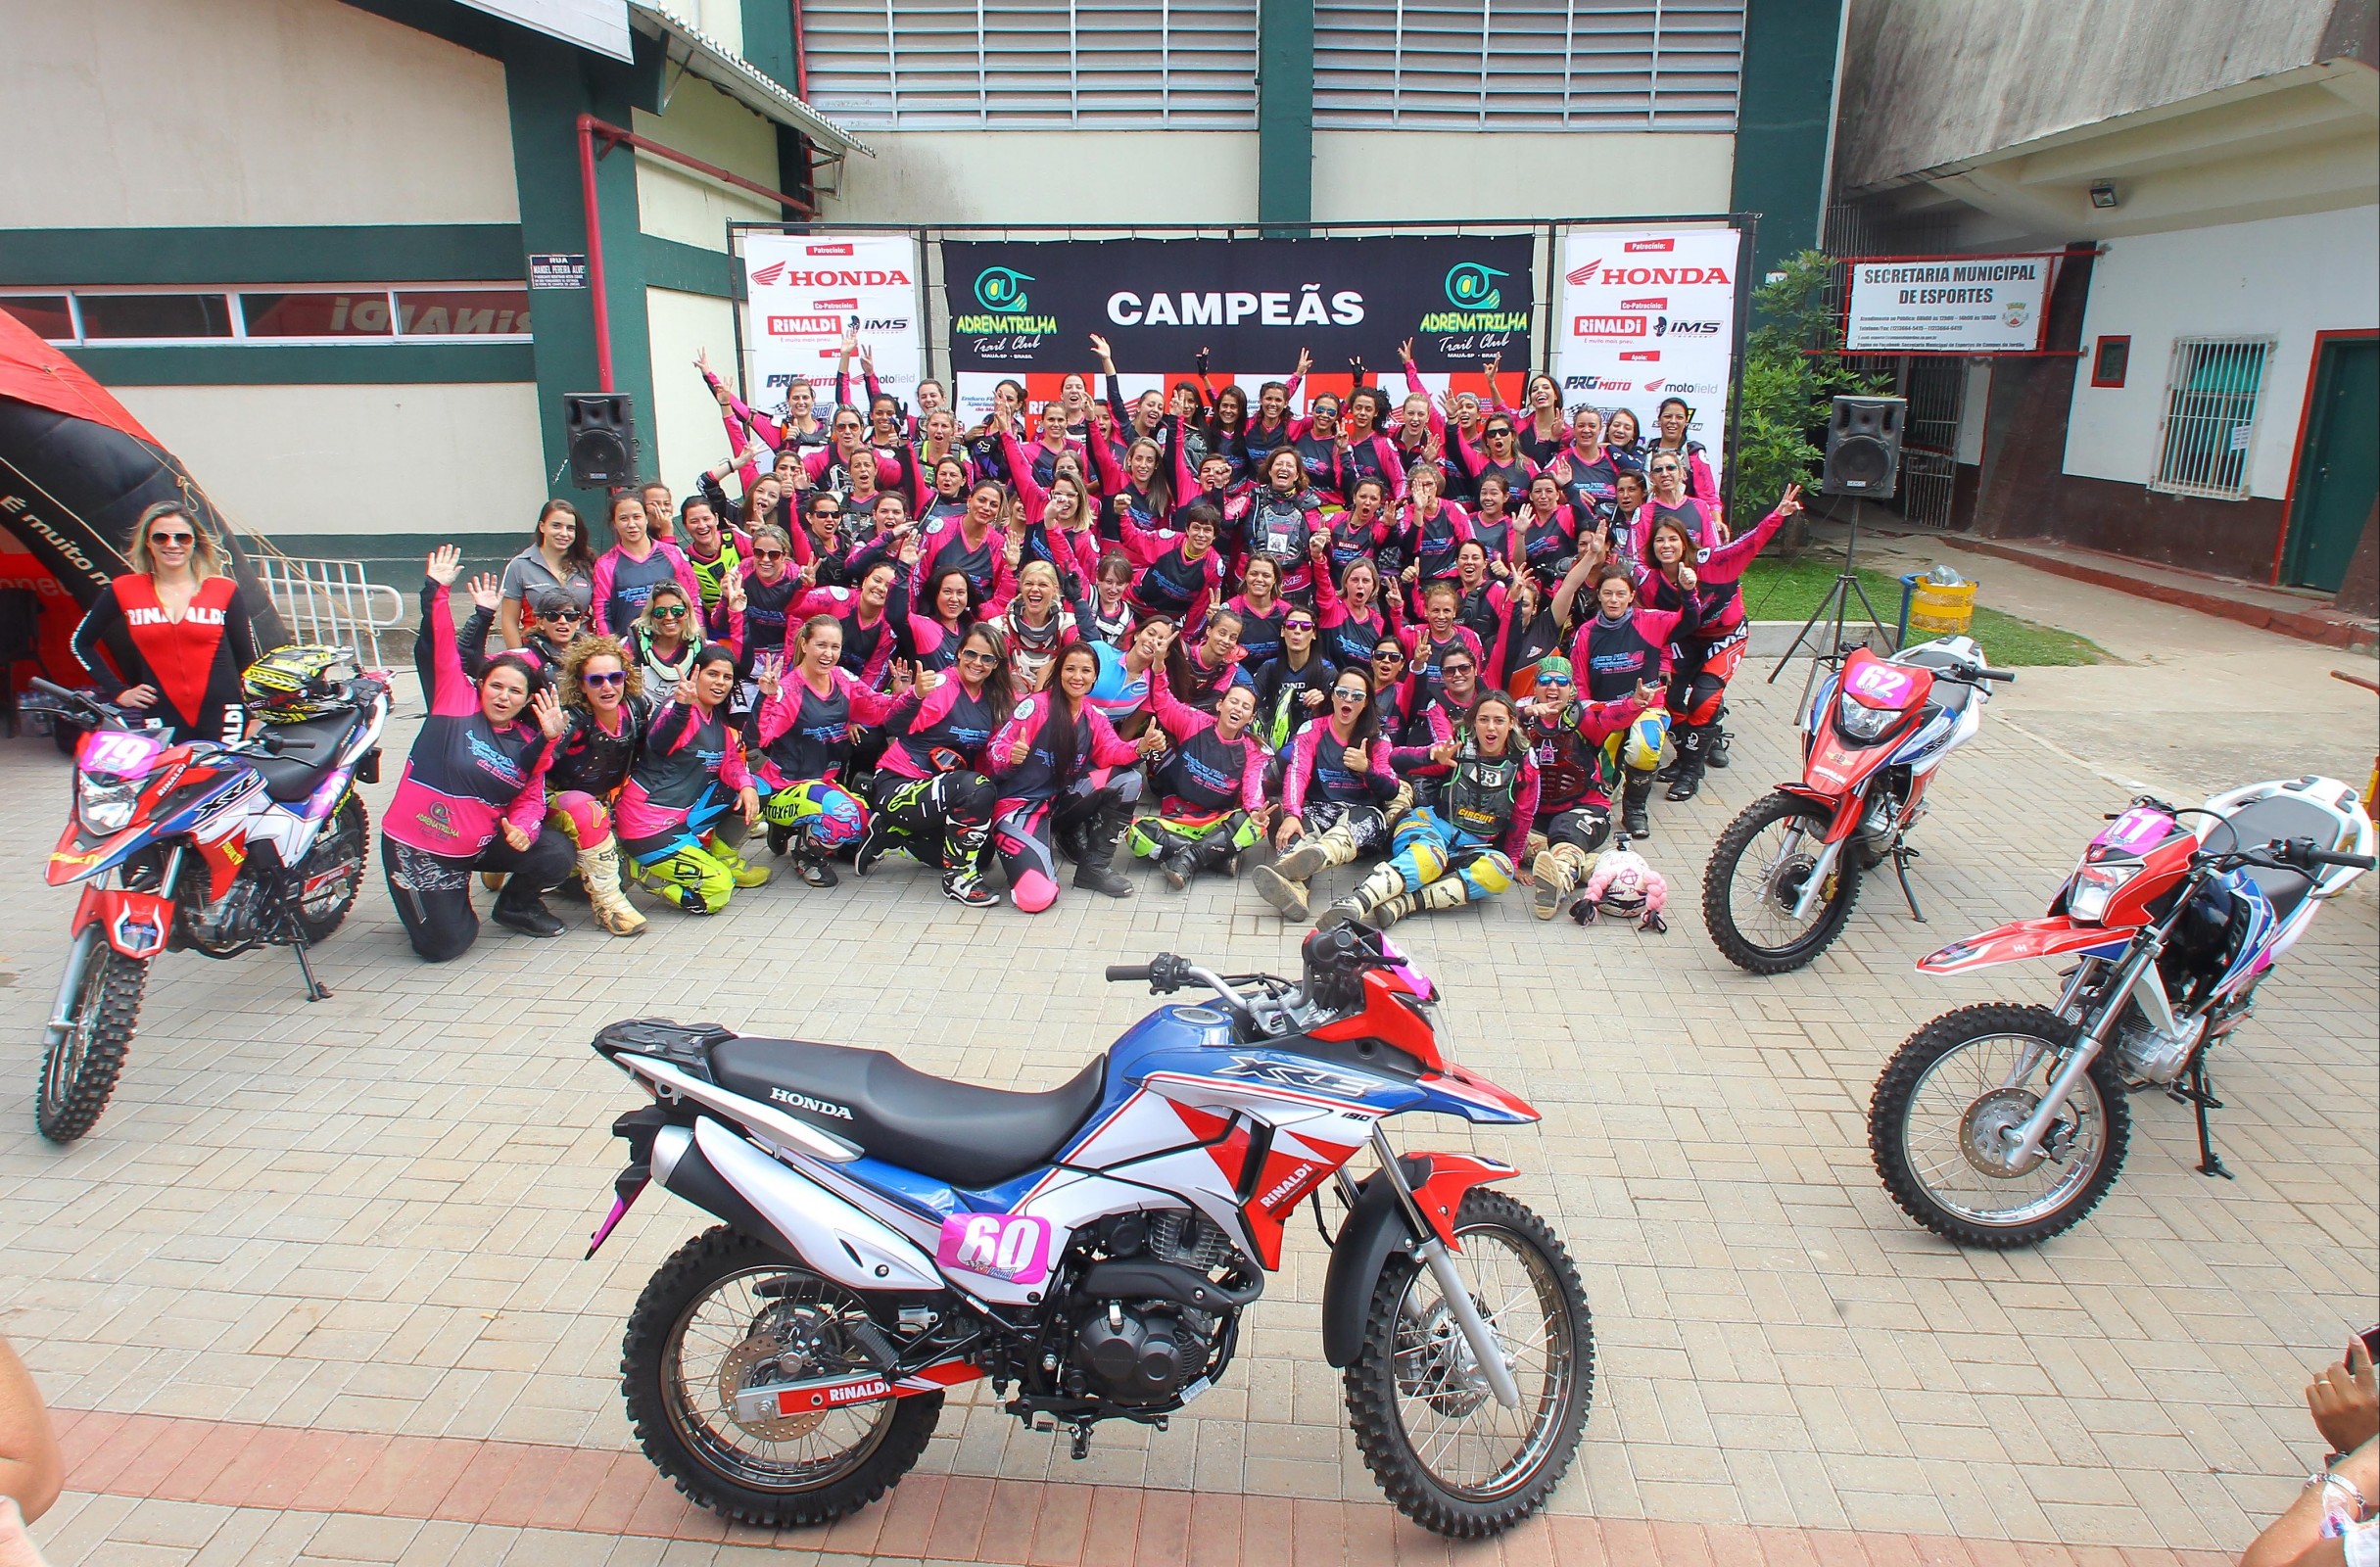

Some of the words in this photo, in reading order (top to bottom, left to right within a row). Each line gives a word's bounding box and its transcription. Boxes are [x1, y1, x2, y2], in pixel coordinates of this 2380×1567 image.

[572, 265, 586, 274] ALVE
[787, 270, 912, 287] HONDA
[1600, 267, 1732, 285] HONDA
[1864, 266, 1950, 285] SECRETARIA
[1952, 264, 2036, 282] MUNICIPAL
[1107, 282, 1365, 326] CAMPEÃS
[1898, 290, 1918, 305] DE
[1920, 288, 1994, 305] ESPORTES
[956, 314, 1058, 335] ADRENATRILHA
[1419, 311, 1528, 333] ADRENATRILHA
[1670, 322, 1721, 333] IMS
[974, 338, 1004, 354] Trail
[1012, 334, 1040, 350] Club
[1438, 335, 1472, 354] Trail
[1479, 331, 1510, 349] Club
[876, 374, 916, 385] otofield
[1598, 381, 1632, 392] MOTO
[1665, 382, 1719, 395] motofield
[0, 496, 26, 513] É
[22, 514, 93, 570] muito
[1855, 665, 1906, 698] 62
[1457, 808, 1495, 823] CIRCUIT
[769, 1086, 854, 1120] HONDA
[1340, 1112, 1372, 1122] 190
[956, 1215, 1042, 1270] 60
